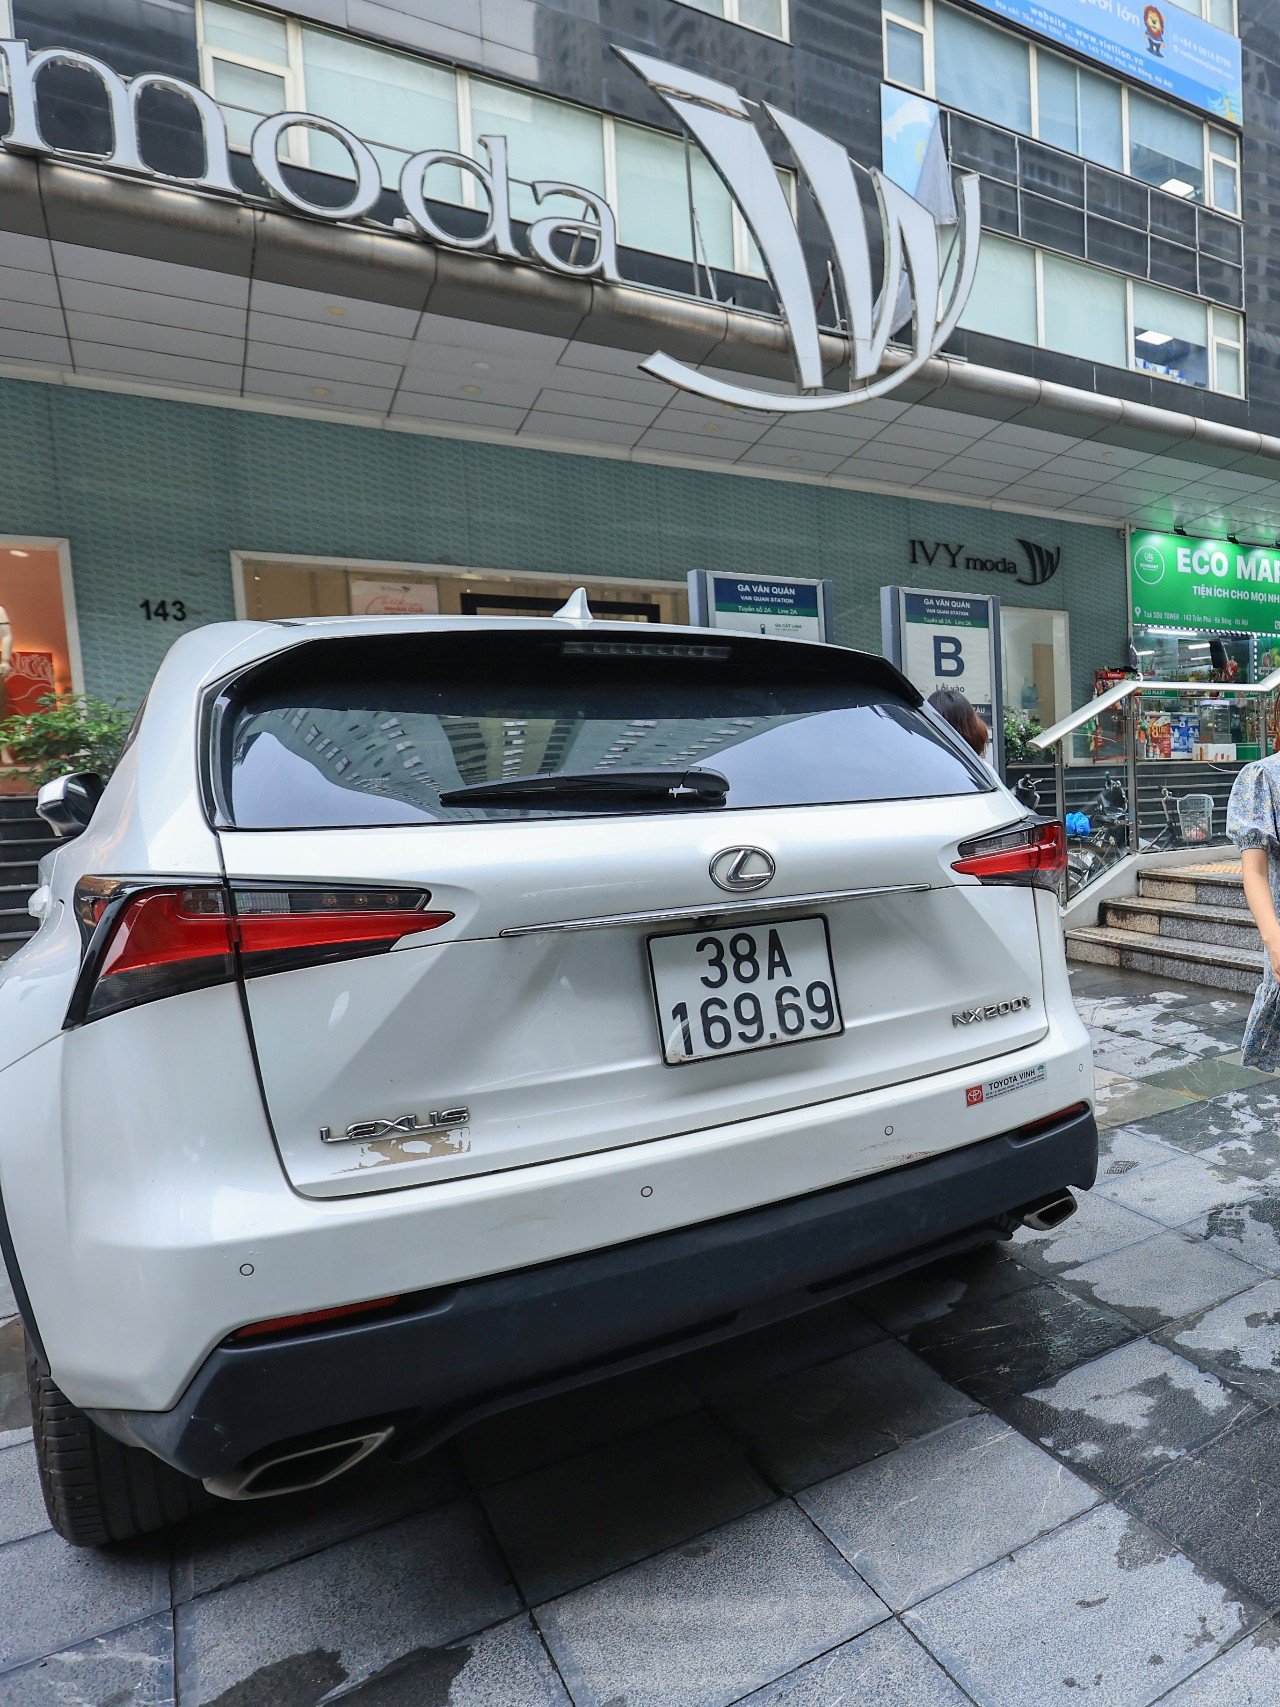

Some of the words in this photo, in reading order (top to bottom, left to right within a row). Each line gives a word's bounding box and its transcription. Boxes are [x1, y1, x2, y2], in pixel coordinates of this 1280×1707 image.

[0, 38, 623, 283] moda
[909, 539, 965, 569] IVY
[965, 557, 1017, 574] moda
[1176, 547, 1229, 577] ECO
[737, 584, 750, 592] GA
[923, 598, 934, 606] GA
[1192, 584, 1213, 598] TIỆN
[1213, 585, 1229, 599] ÍCH
[1230, 588, 1250, 600] CHO
[1250, 591, 1267, 605] MỌI
[139, 599, 187, 622] 143
[933, 635, 965, 677] B
[696, 928, 793, 989] 38A
[671, 980, 835, 1056] 169.69
[988, 1075, 1018, 1092] TOYOTA
[1018, 1068, 1036, 1081] VINH
[319, 1106, 471, 1144] LEXUS
